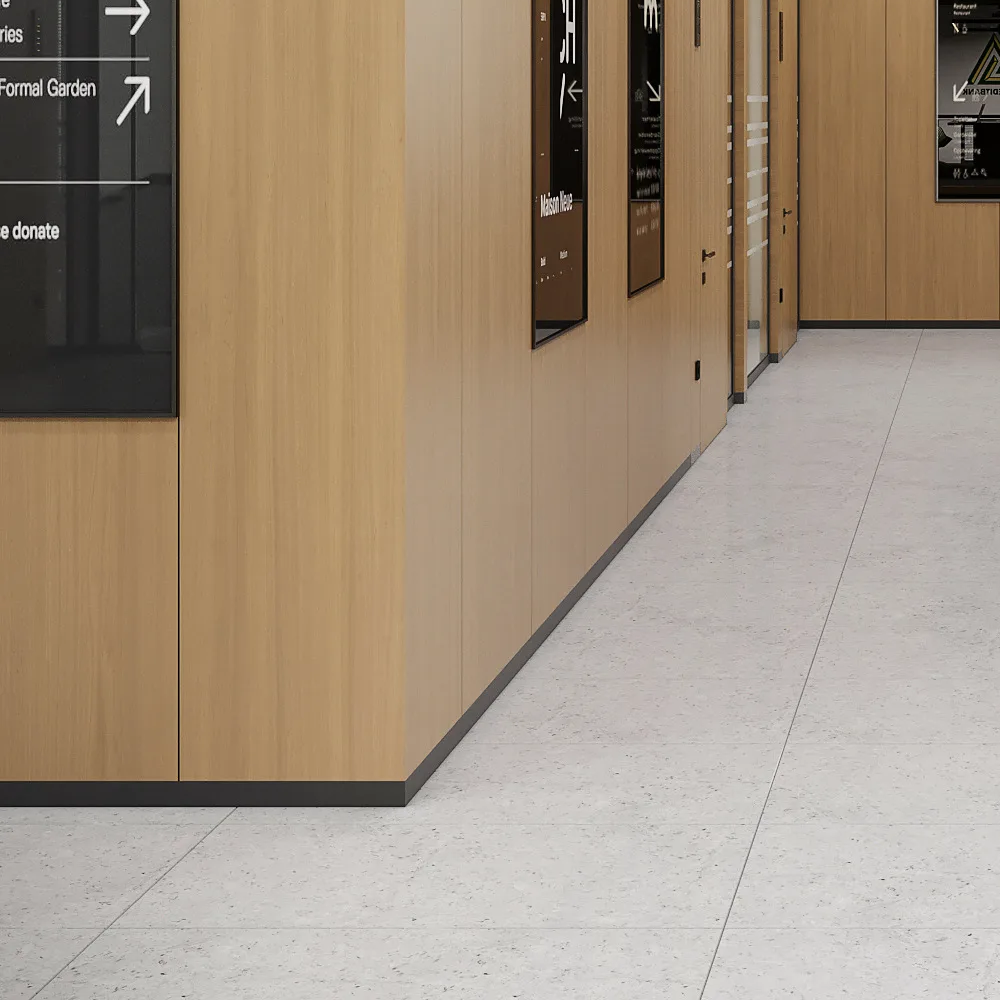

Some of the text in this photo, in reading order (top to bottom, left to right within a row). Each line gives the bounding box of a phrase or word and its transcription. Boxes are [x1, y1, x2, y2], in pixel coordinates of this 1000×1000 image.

[0, 25, 23, 43] ries
[0, 77, 96, 97] Formal Garden
[12, 220, 60, 240] donate
